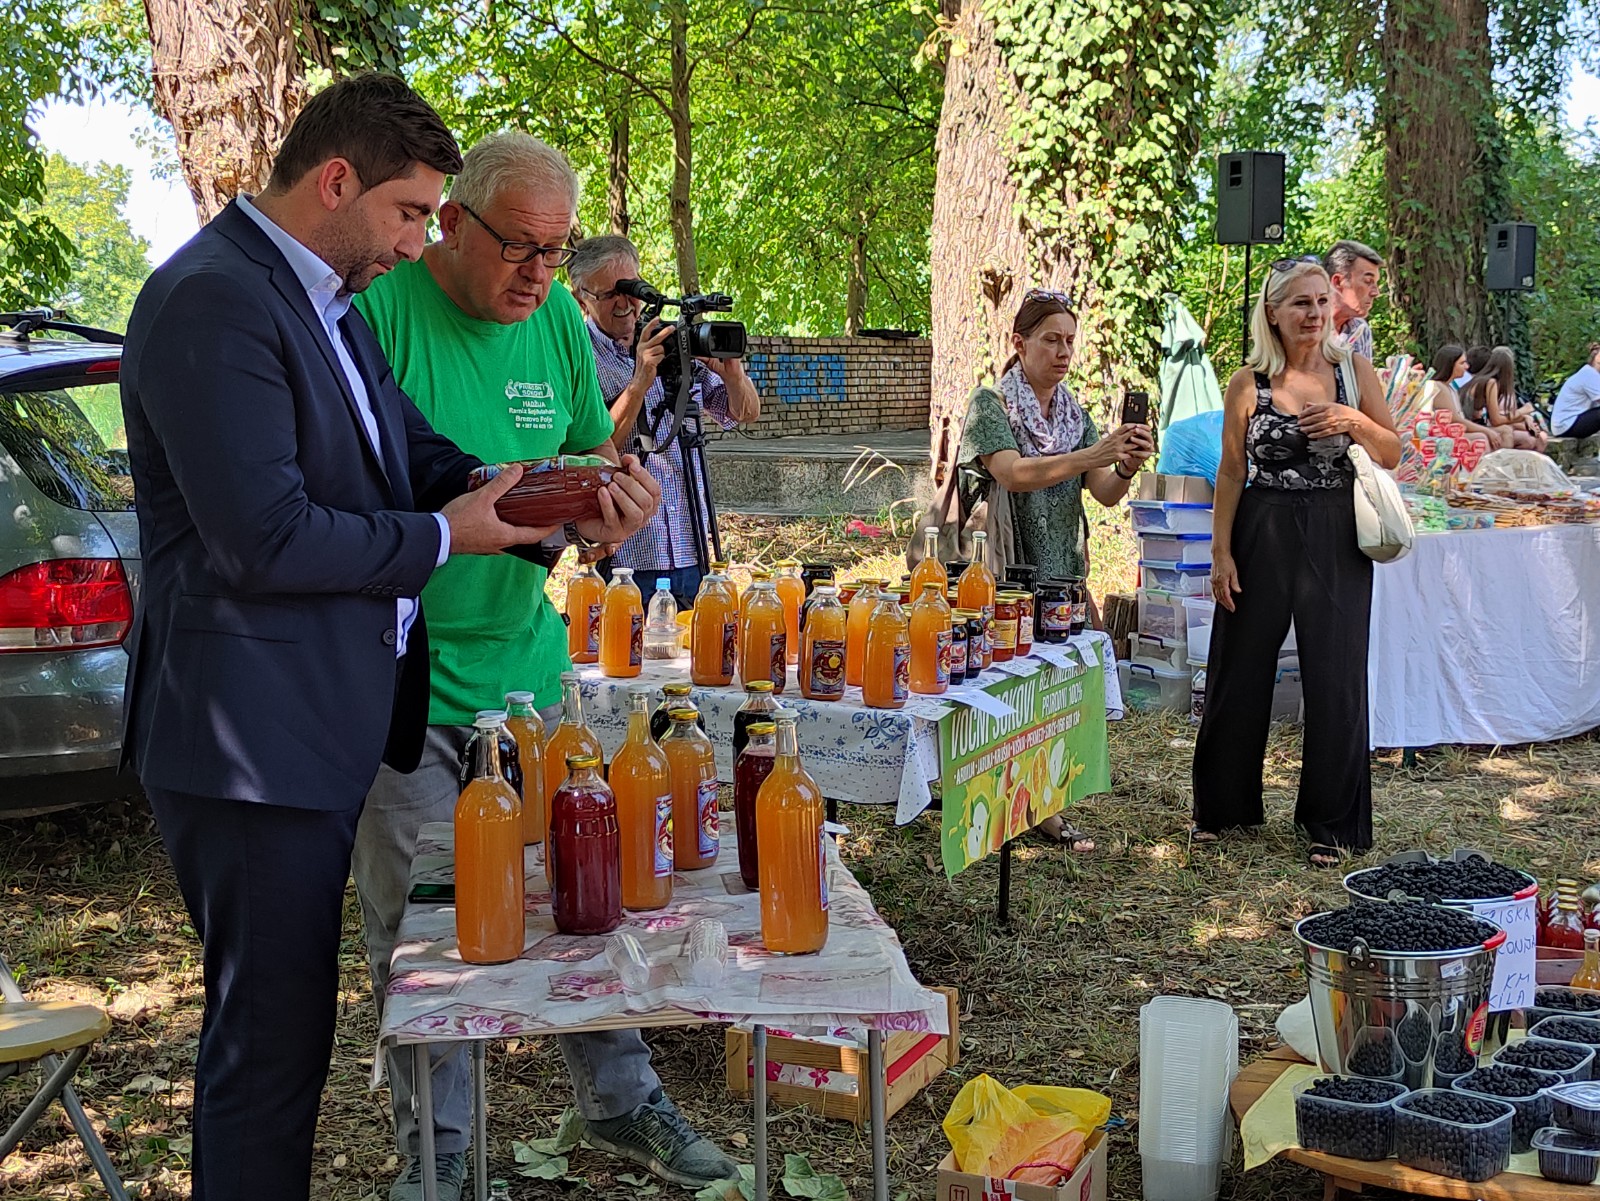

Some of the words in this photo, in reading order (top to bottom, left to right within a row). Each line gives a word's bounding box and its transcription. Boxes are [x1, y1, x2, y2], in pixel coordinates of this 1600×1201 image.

[680, 330, 688, 354] SONY
[1039, 667, 1052, 692] BEZ
[992, 678, 1037, 740] SOKOVI
[1042, 686, 1068, 719] PRIRODNI
[1068, 681, 1083, 706] 100%
[1503, 972, 1530, 992] KM
